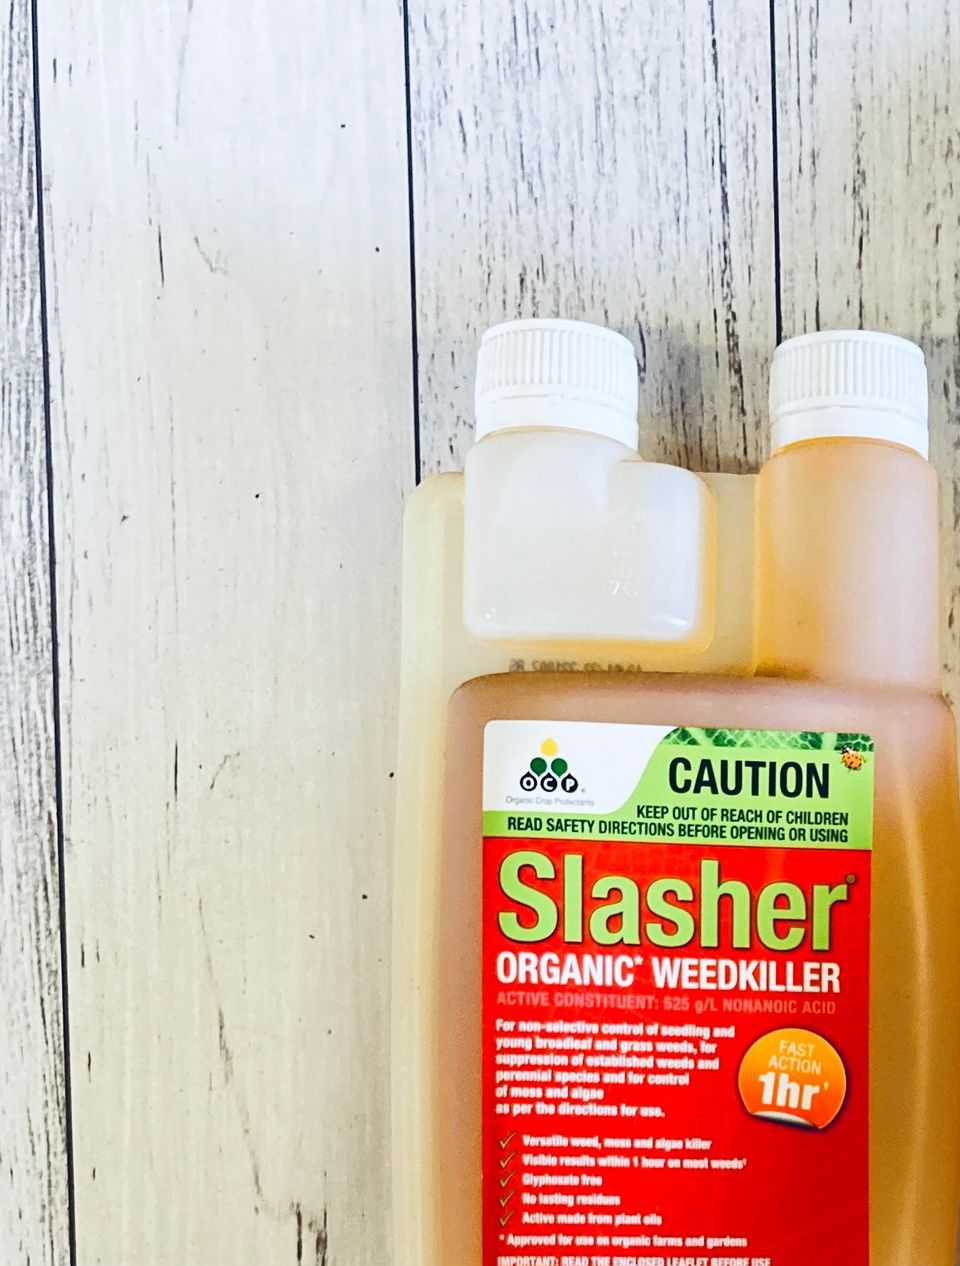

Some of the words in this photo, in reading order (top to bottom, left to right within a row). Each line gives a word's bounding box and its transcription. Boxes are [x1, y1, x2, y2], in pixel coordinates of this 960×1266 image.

[668, 756, 829, 799] CAUTION
[636, 805, 669, 819] KEEP
[672, 806, 697, 821] OUT
[700, 807, 717, 821] OF
[720, 808, 762, 823] REACH
[766, 809, 782, 824] OF
[785, 810, 848, 826] CHILDREN
[507, 816, 542, 831] READ
[546, 817, 594, 833] SAFETY
[598, 819, 674, 836] DIRECTIONS
[678, 823, 726, 838] BEFORE
[730, 825, 785, 840] OPENING
[788, 826, 806, 841] OR
[809, 827, 848, 843] USING
[651, 956, 839, 993] WEEDKILLER
[779, 1040, 814, 1057] FAST
[768, 1056, 821, 1074] ACTION
